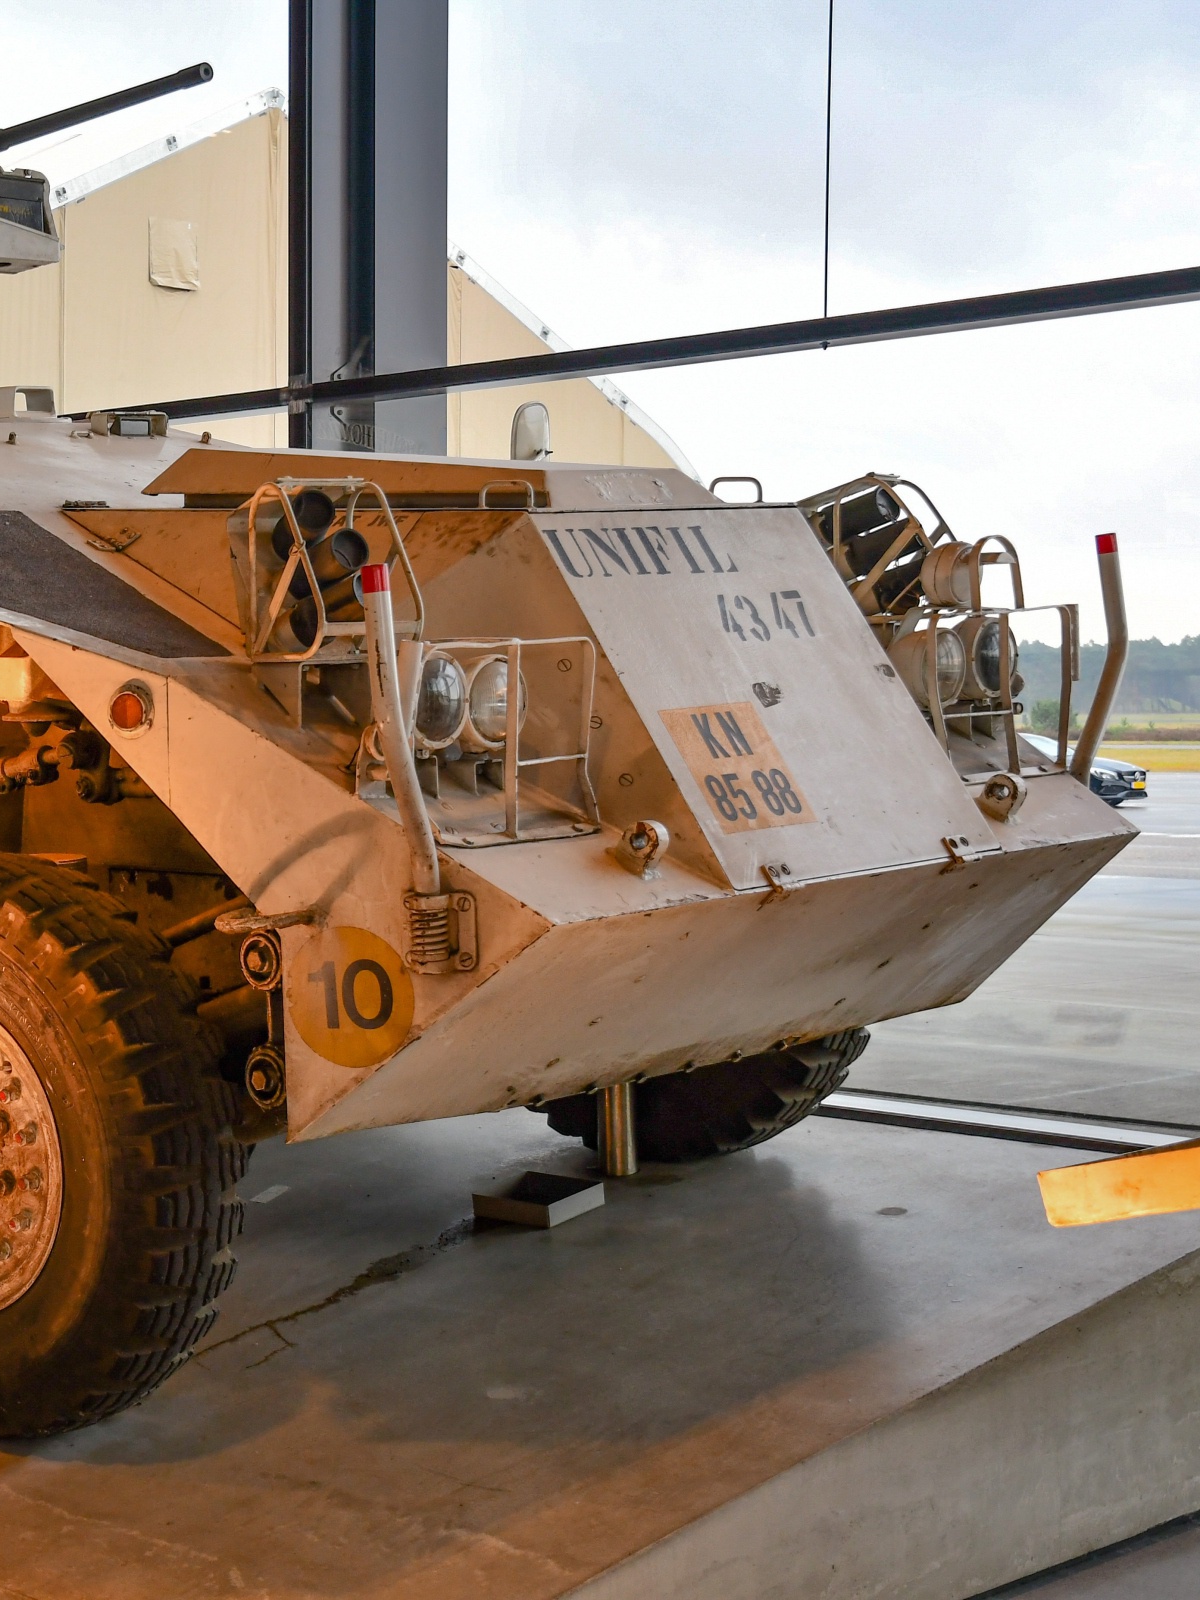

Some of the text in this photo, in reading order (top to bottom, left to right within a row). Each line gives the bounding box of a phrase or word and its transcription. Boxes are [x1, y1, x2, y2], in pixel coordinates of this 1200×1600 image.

[542, 526, 739, 578] UNIFIL
[690, 711, 754, 759] KN
[307, 958, 394, 1030] 10
